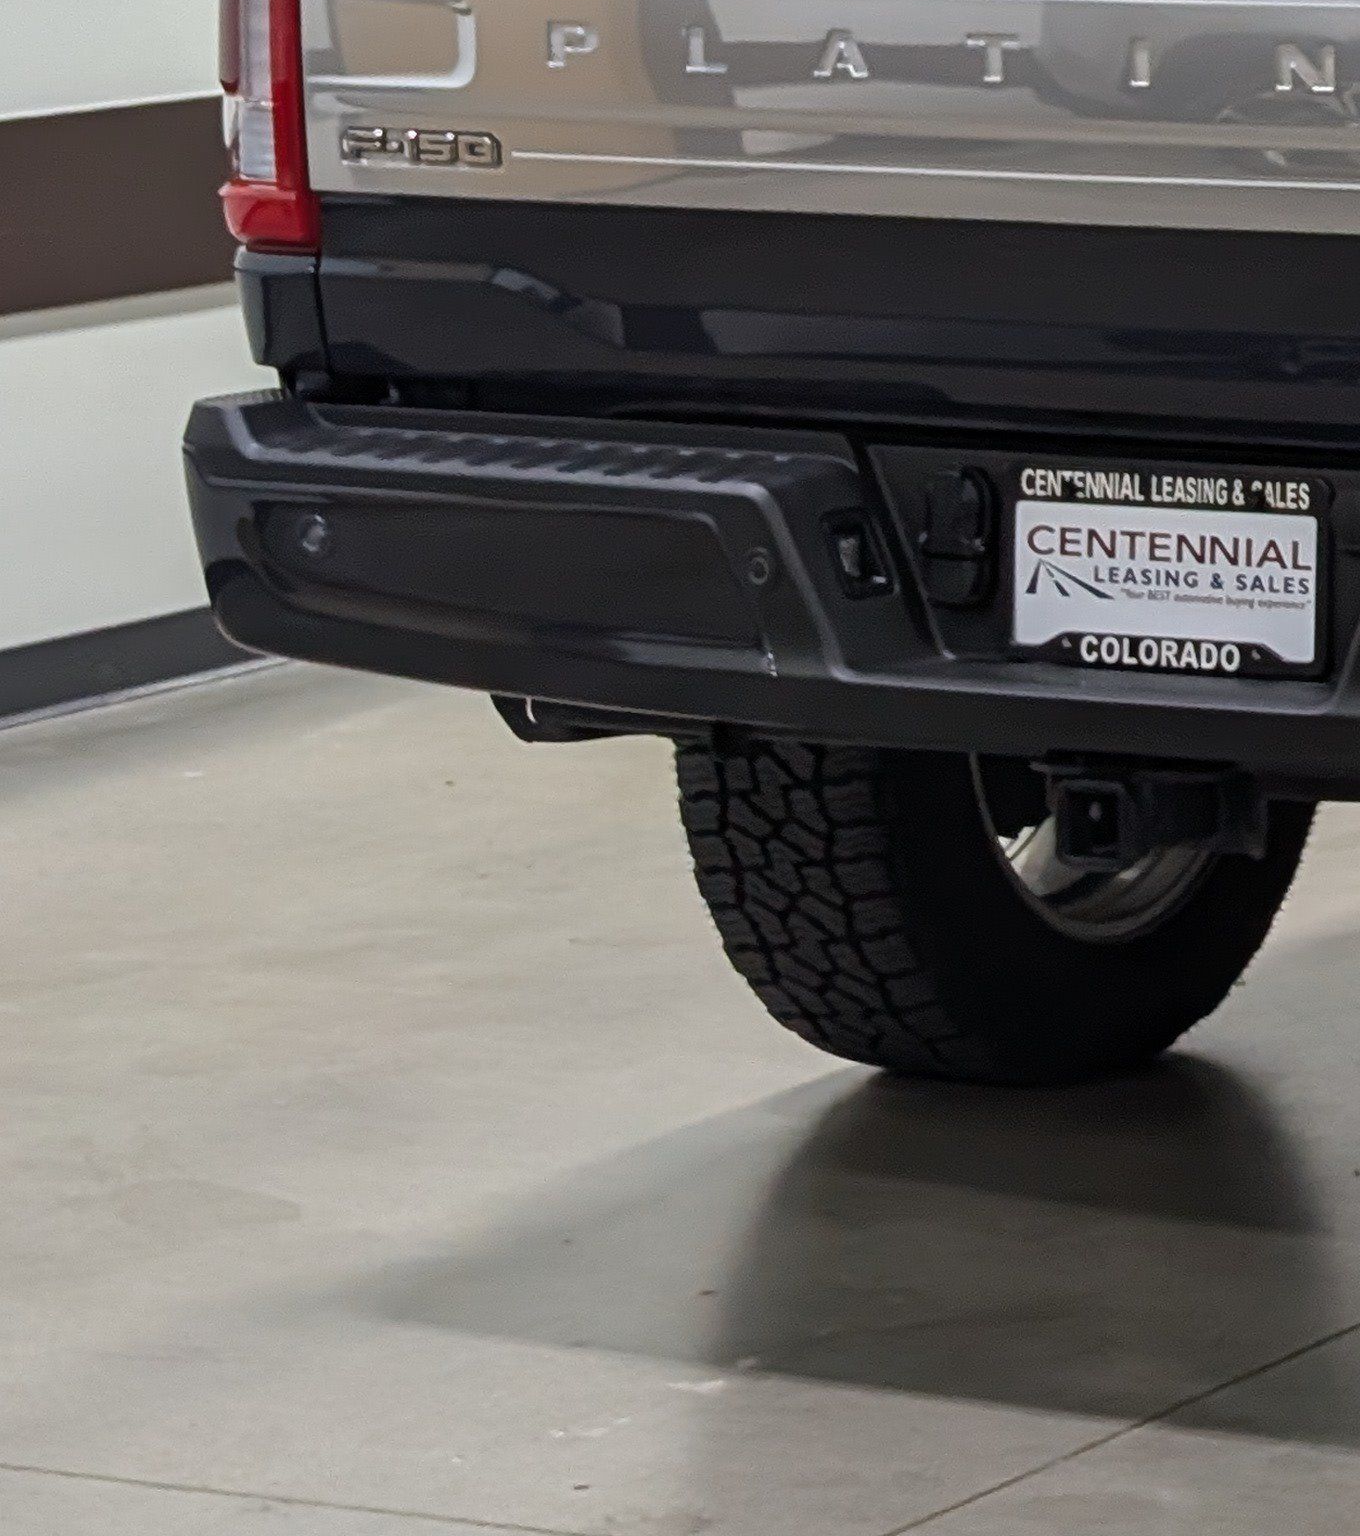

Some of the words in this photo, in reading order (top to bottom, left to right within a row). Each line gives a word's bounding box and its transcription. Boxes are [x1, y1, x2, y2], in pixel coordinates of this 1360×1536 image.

[1151, 474, 1228, 506] LEASING
[1232, 479, 1245, 506] &
[1026, 524, 1313, 571] CENTENNIAL
[1093, 565, 1200, 589] LEASING
[1210, 573, 1225, 590] &
[1236, 574, 1311, 595] SALES
[1080, 635, 1241, 673] COLORADO
